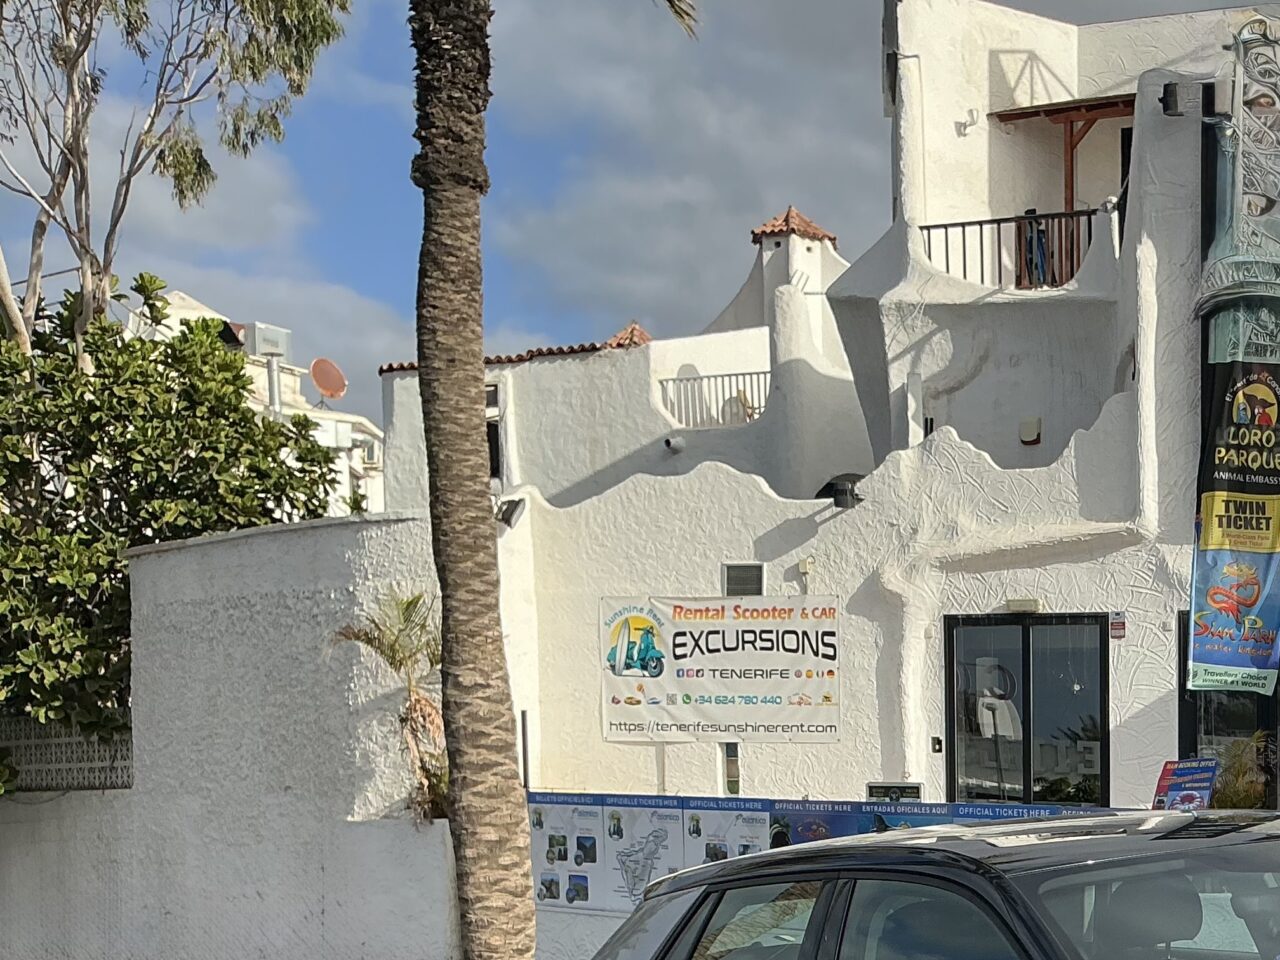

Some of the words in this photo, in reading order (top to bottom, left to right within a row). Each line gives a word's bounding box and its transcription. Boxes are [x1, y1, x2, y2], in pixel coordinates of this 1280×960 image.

[1229, 426, 1276, 448] LORO
[1213, 470, 1244, 482] ANIMAL
[1222, 499, 1266, 516] TWIN
[1215, 514, 1273, 531] TICKET
[604, 605, 645, 629] Sunshine
[646, 608, 665, 628] Rent
[672, 605, 726, 621] Rental
[732, 604, 795, 621] Scooter
[799, 607, 809, 619] &
[811, 607, 837, 620] CAR
[672, 629, 838, 661] EXCURSIONS
[708, 668, 791, 680] TENERIFE
[1241, 672, 1268, 681] Choice
[1202, 677, 1228, 685] WINNER
[1241, 680, 1267, 688] WORLD
[694, 695, 712, 705] +34
[714, 696, 736, 705] 624
[738, 696, 759, 705] 780
[760, 696, 783, 705] 440
[609, 721, 838, 735] https://tenerifesunshinerent.com
[689, 800, 717, 809] OFFICIAL
[718, 801, 745, 810] TICKETS
[745, 802, 763, 810] HERE
[775, 802, 803, 811] OFFICIAL
[805, 803, 832, 811] TICKETS
[834, 804, 852, 812] HERE
[862, 805, 895, 813] ENTRADAS
[896, 805, 930, 814] OFICIALES
[959, 807, 994, 816] OFFICIAL
[995, 808, 1028, 818] TICKETS
